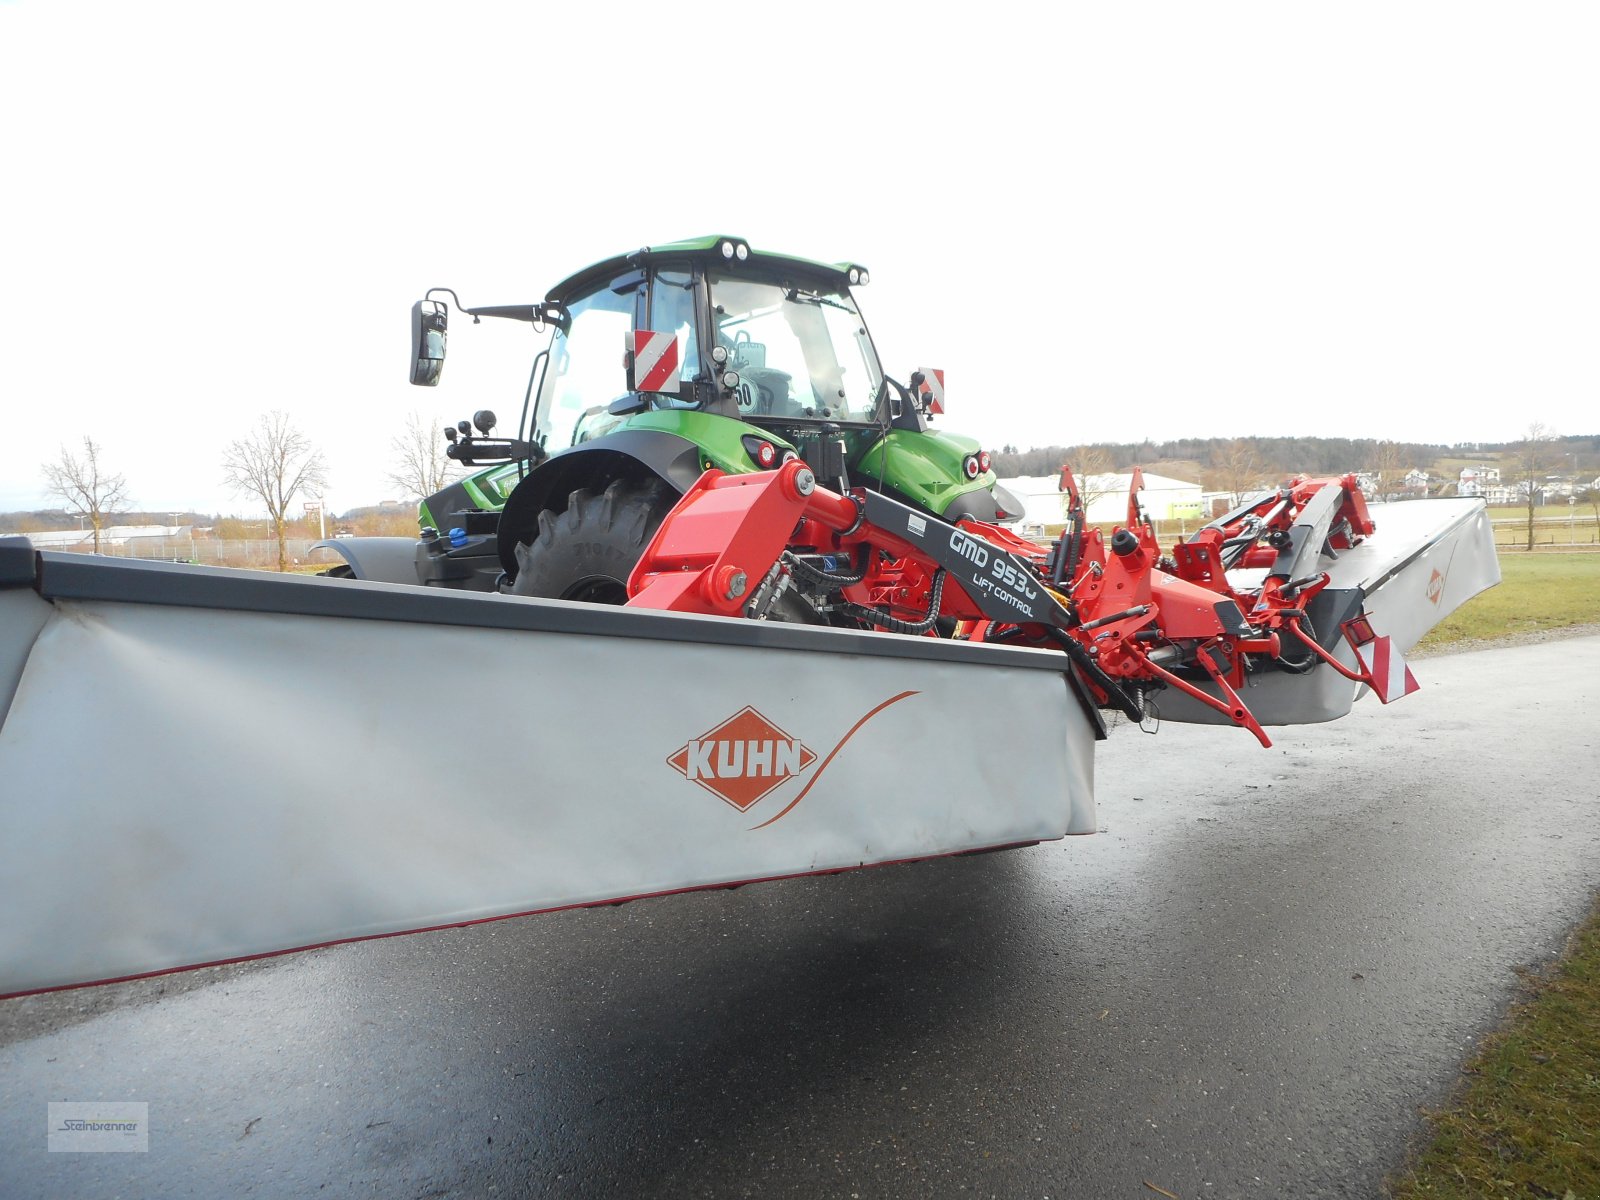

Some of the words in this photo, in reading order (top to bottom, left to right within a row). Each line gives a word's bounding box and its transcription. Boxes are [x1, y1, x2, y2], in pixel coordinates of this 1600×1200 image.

[949, 530, 988, 567] GMD
[972, 573, 994, 592] LIFT
[994, 587, 1034, 618] CONTROL
[687, 740, 801, 780] KUHN
